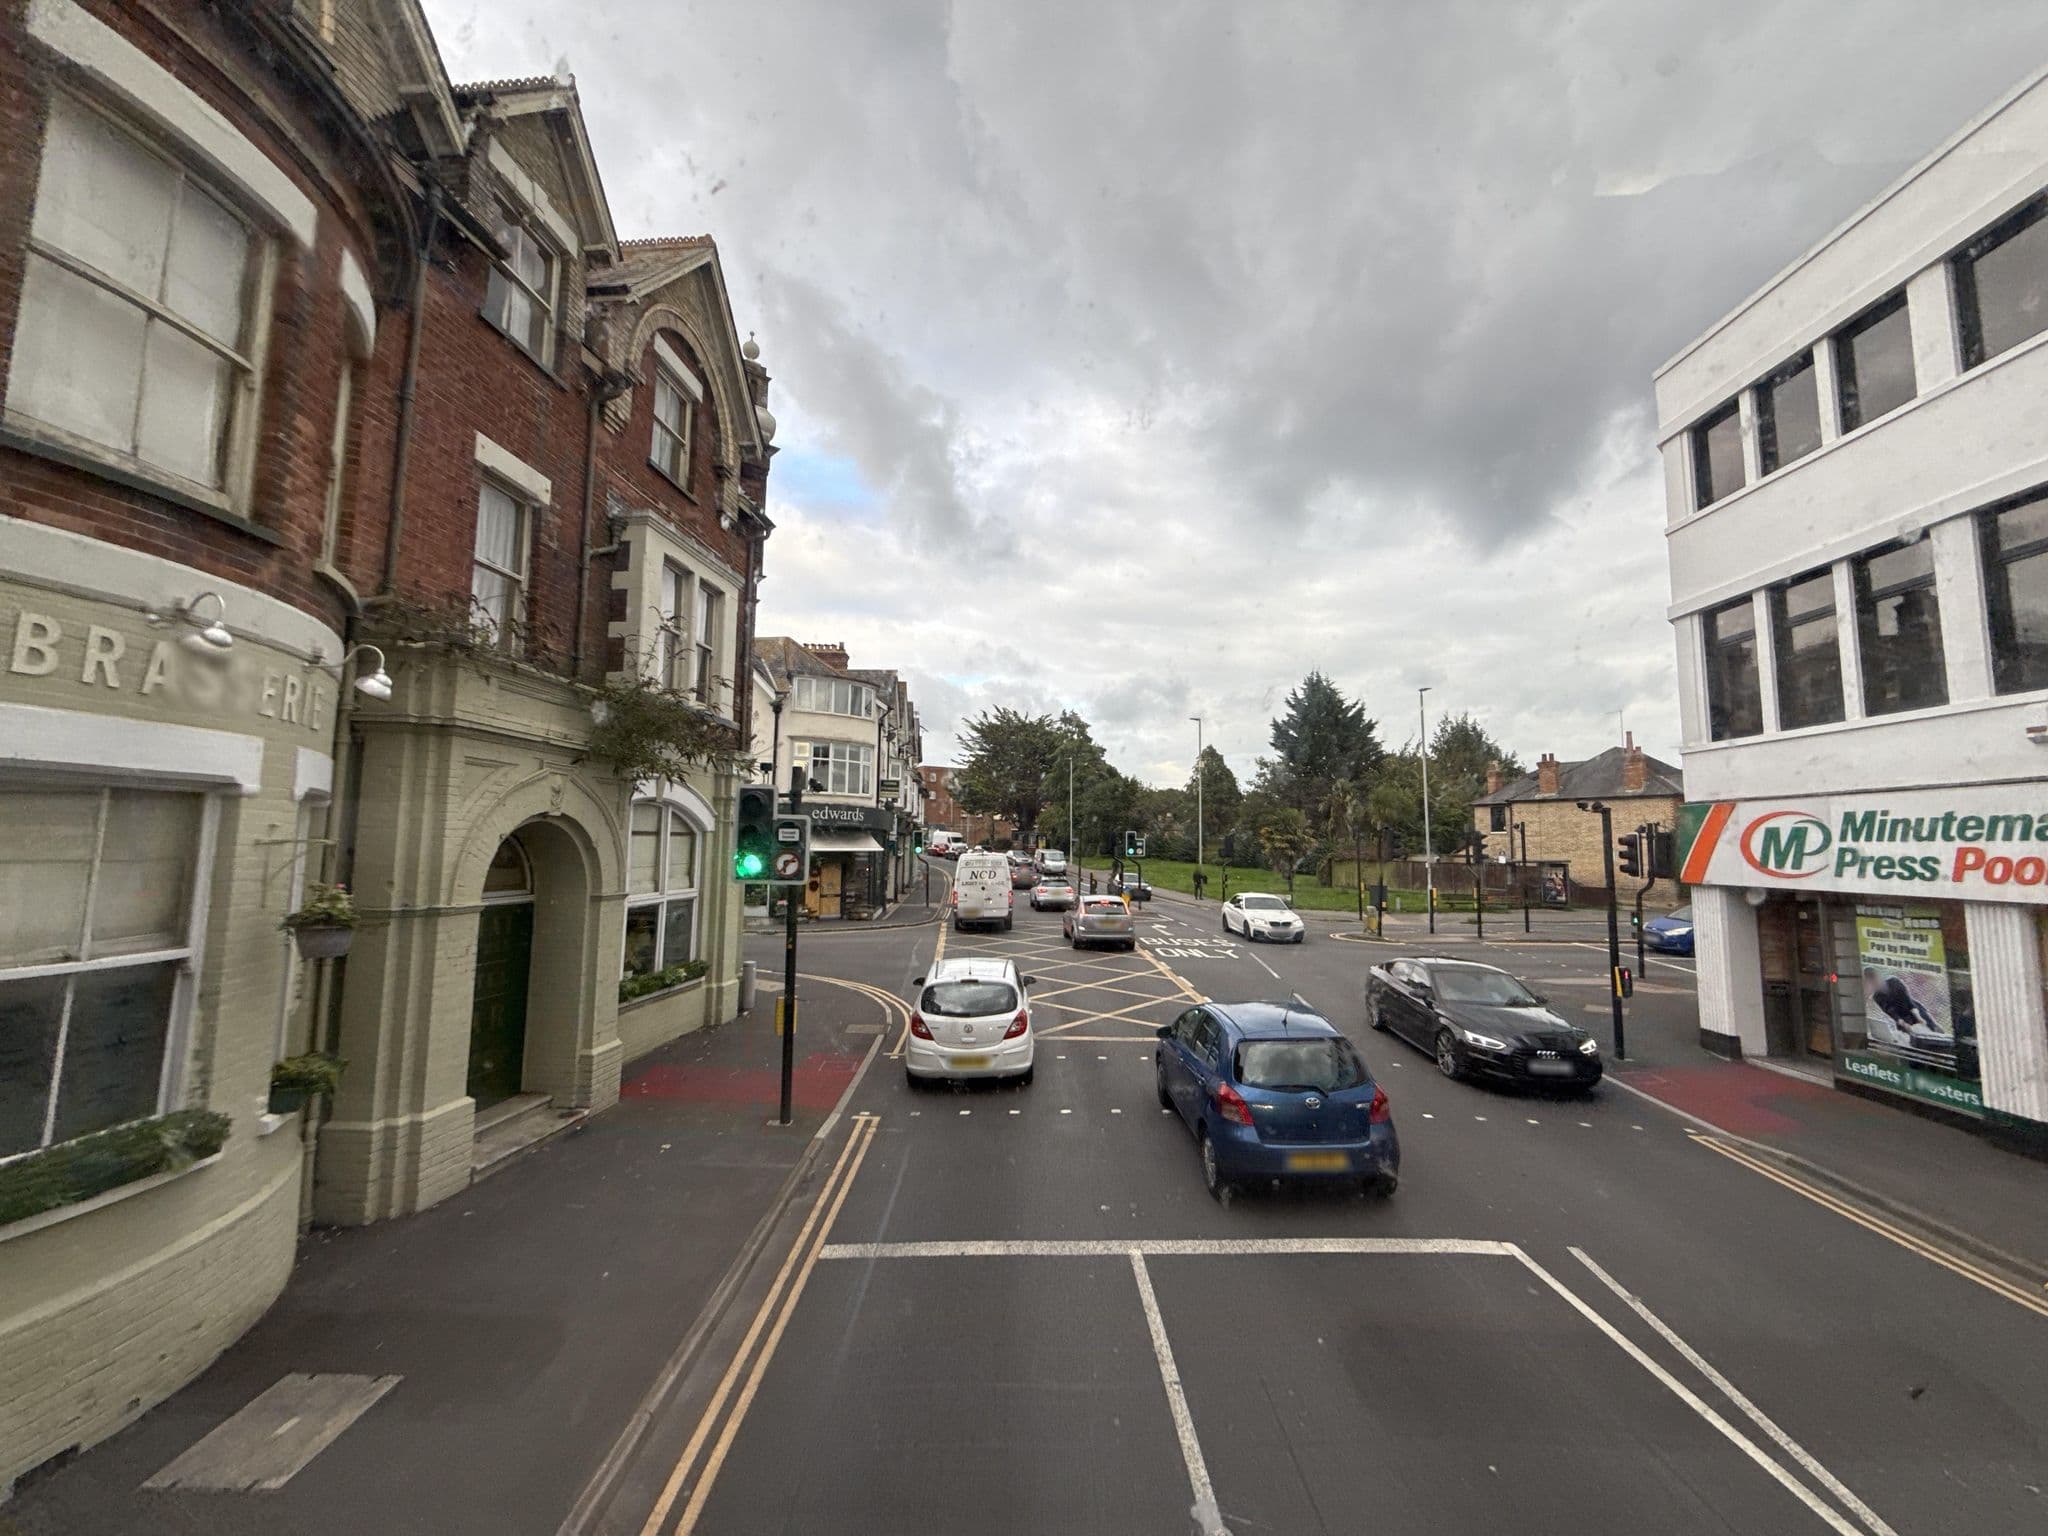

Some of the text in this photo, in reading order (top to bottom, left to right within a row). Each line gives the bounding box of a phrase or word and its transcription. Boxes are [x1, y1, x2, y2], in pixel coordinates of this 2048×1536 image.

[811, 806, 865, 821] edwards
[1834, 847, 2048, 886] Press Poo
[970, 870, 997, 880] NCD
[1140, 937, 1236, 947] BUSES
[1155, 948, 1239, 959] ONLY
[1845, 1056, 1901, 1084] Leaflets
